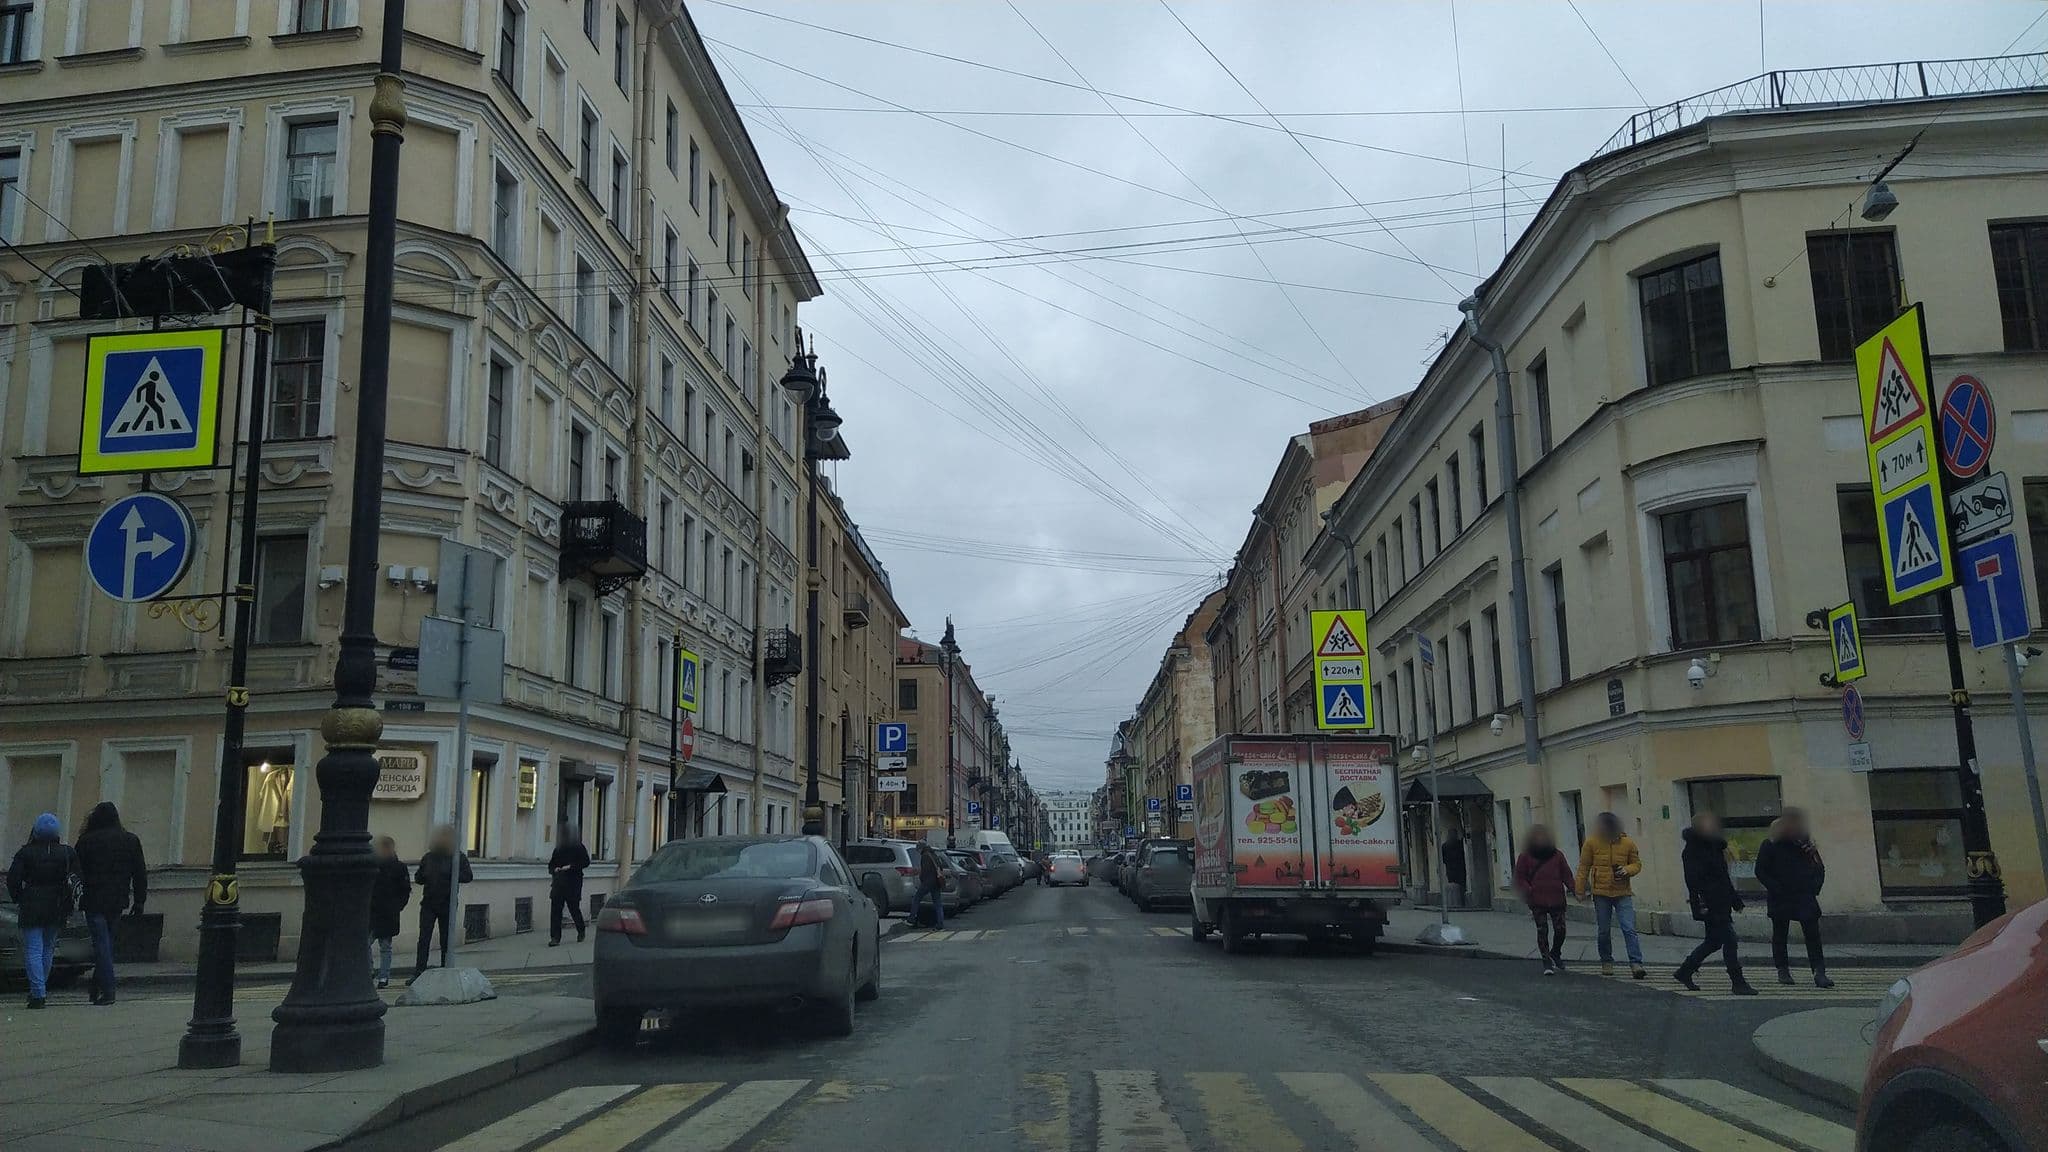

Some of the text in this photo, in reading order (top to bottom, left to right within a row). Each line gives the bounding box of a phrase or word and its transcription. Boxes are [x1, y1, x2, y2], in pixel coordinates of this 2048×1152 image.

[1891, 453, 1913, 473] 70м
[1331, 666, 1354, 675] 220м
[886, 726, 902, 749] P
[376, 784, 417, 793] ОДЕЖДА
[1181, 786, 1189, 799] P
[970, 802, 978, 813] P
[1151, 799, 1158, 809] P
[993, 816, 998, 825] P
[1258, 836, 1298, 844] 925-55-16
[1330, 837, 1395, 845] cheese-cake.ru
